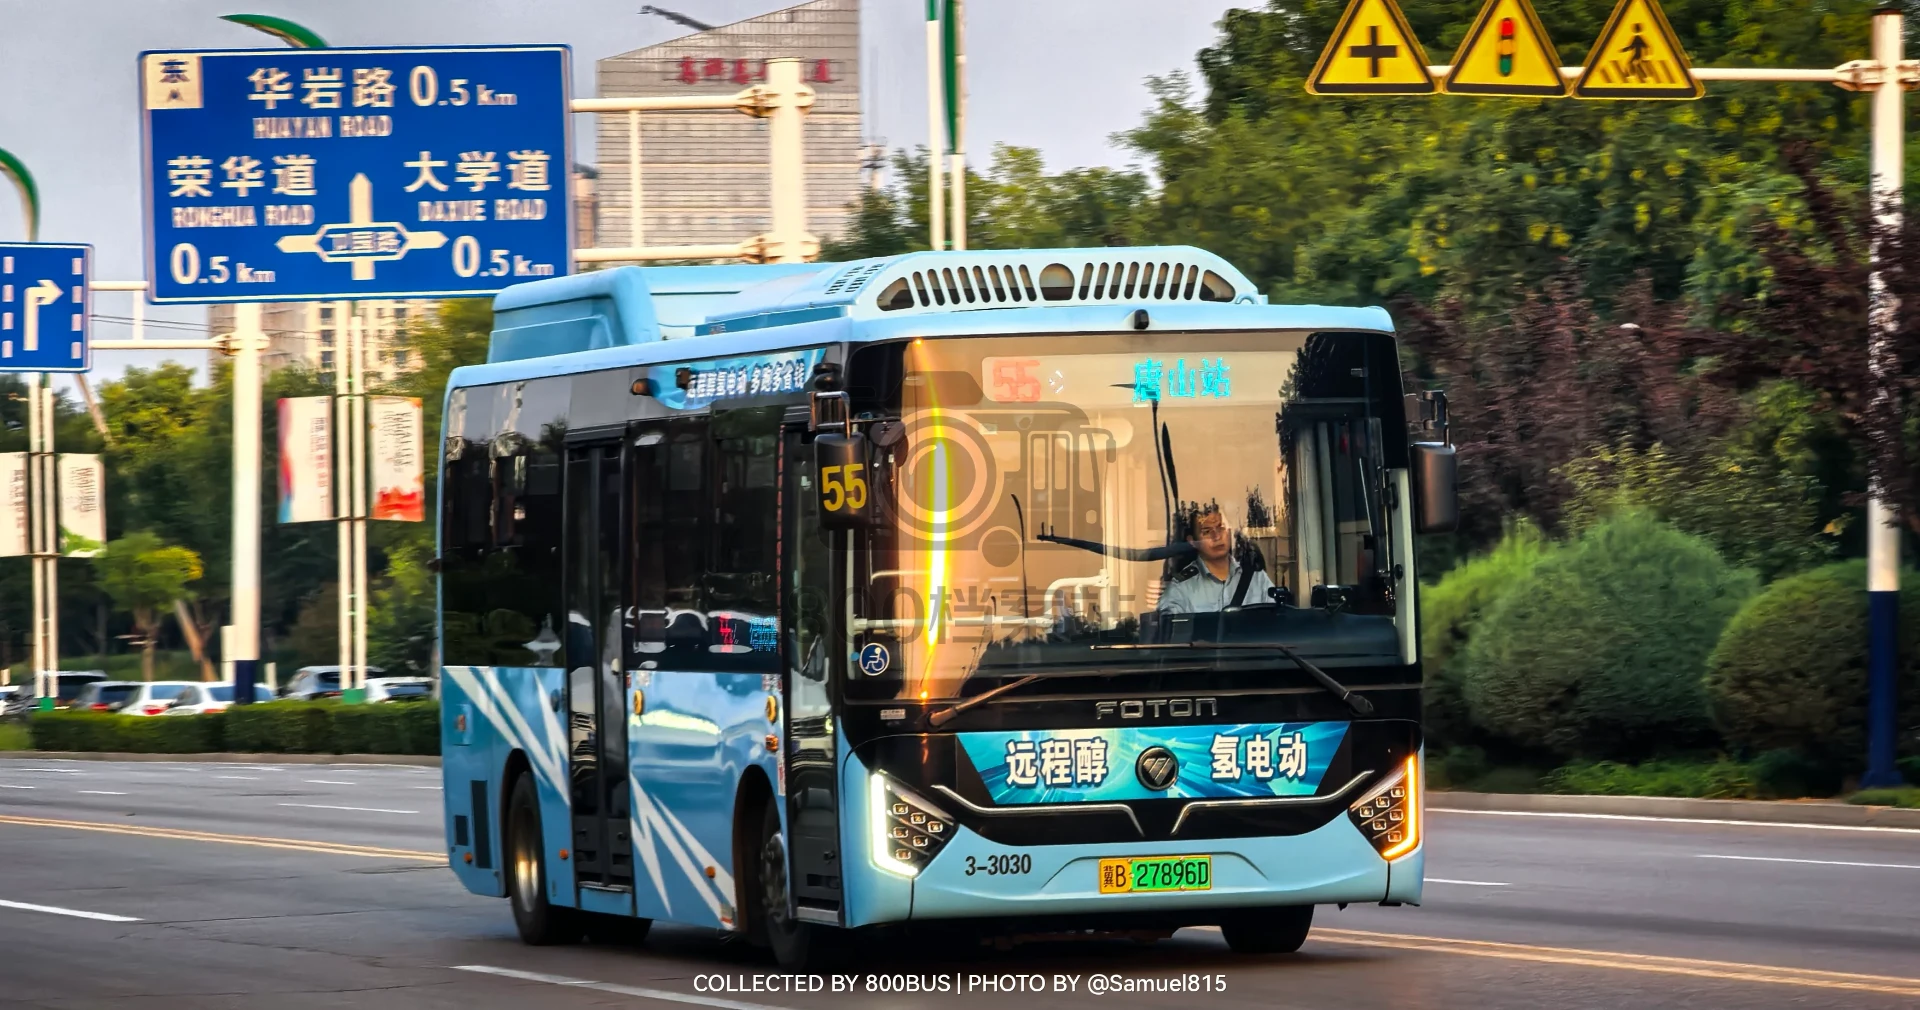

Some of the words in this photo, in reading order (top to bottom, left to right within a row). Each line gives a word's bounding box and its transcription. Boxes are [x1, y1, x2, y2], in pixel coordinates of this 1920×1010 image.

[158, 59, 190, 83] 东
[247, 67, 397, 109] 华岩路
[409, 65, 470, 106] 0.5
[476, 84, 517, 105] km
[252, 116, 332, 139] HUAYAN
[339, 115, 393, 137] ROAD
[167, 154, 318, 197] 荣华道
[403, 150, 551, 192] 大学道
[172, 206, 257, 228] RONGHUA
[264, 205, 315, 226] ROAD
[418, 201, 486, 221] DAXUE
[494, 199, 547, 220] ROAD
[170, 243, 230, 284] 0.5
[236, 262, 276, 283] km
[452, 236, 510, 277] 0.5
[513, 255, 554, 276] km
[993, 360, 1041, 403] 55
[1133, 357, 1230, 402] 唐山站
[822, 463, 867, 511] 55
[1095, 698, 1218, 720] FOTON
[1005, 737, 1107, 787] 远程醇
[1210, 732, 1307, 780] 氢电动
[965, 854, 1031, 876] 3-3030
[1136, 861, 1209, 888] 27896D
